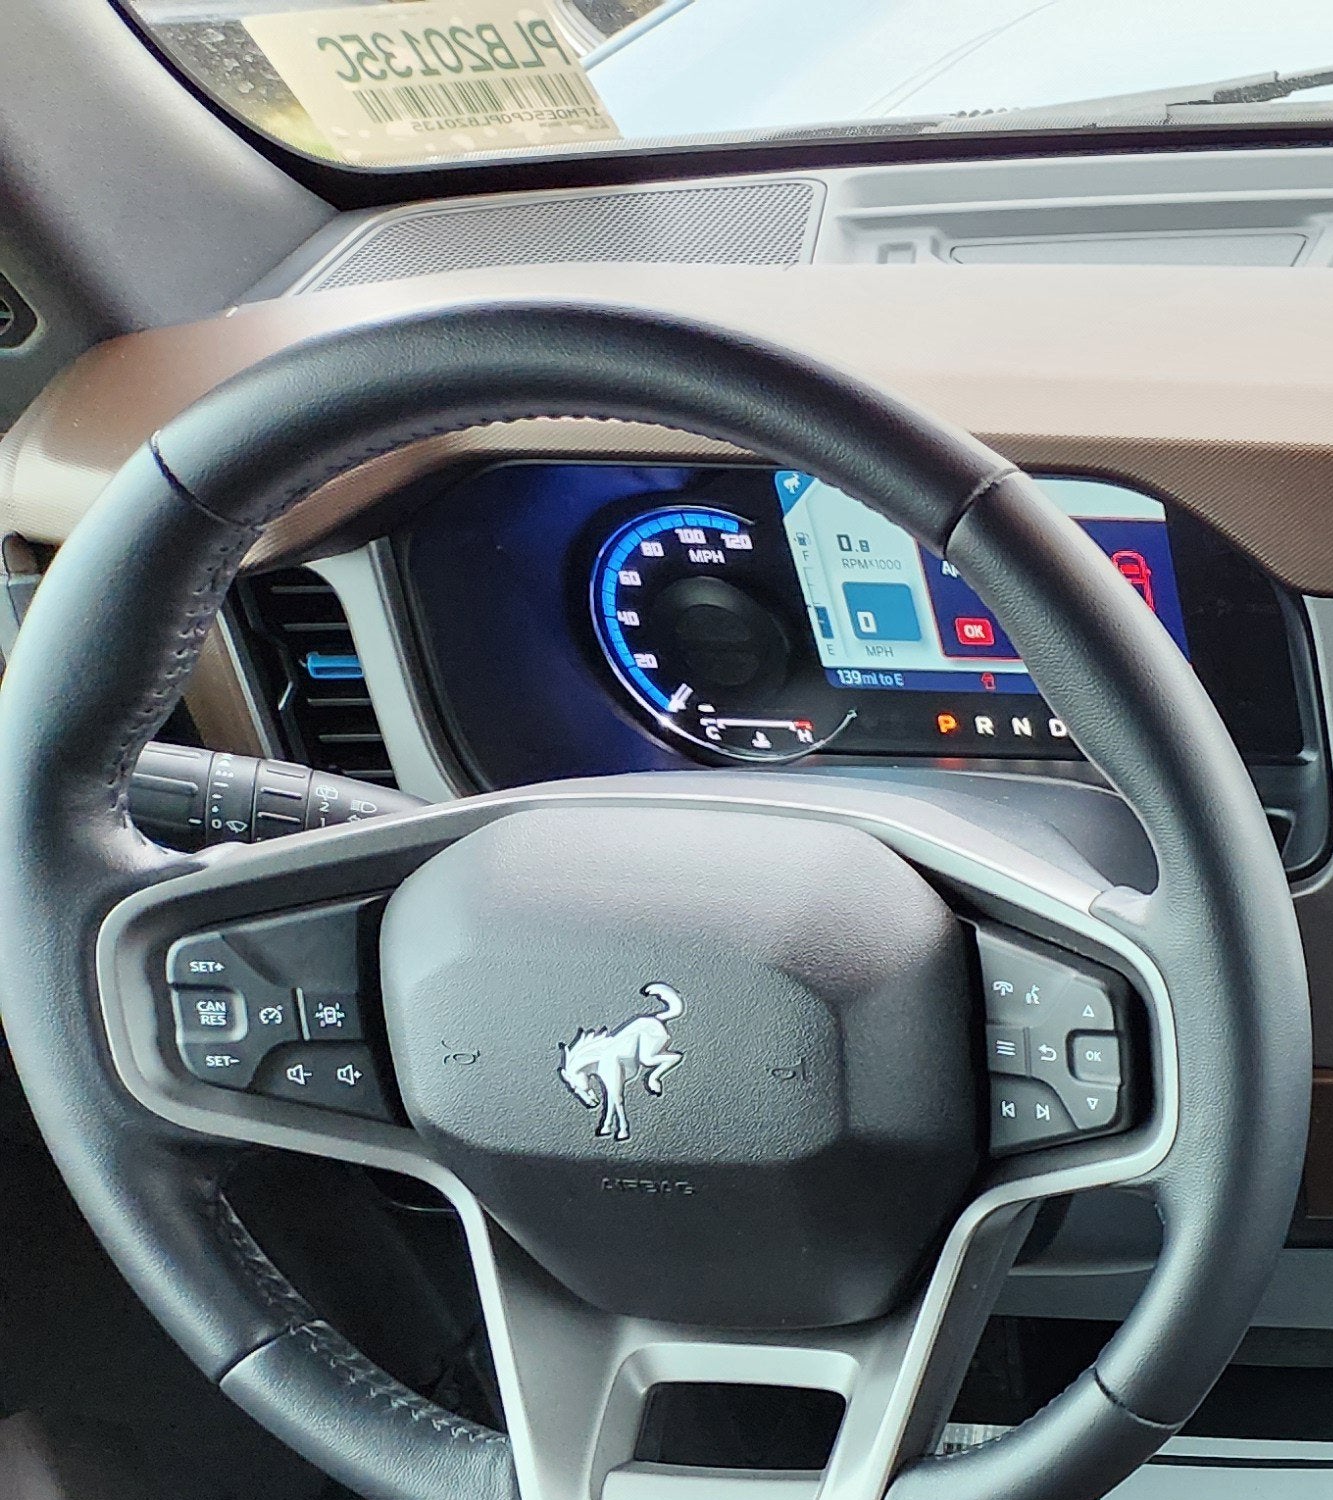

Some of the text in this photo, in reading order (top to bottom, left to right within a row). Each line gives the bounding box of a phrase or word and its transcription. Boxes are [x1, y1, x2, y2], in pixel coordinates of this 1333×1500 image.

[675, 529, 706, 544] 100
[721, 533, 753, 549] 120
[836, 534, 871, 553] 0.8
[641, 542, 664, 556] 80
[688, 549, 726, 564] MPH
[618, 570, 642, 586] 60
[616, 610, 640, 626] 40
[856, 611, 877, 633] 0
[963, 624, 986, 639] OK
[826, 644, 835, 656] E
[865, 645, 894, 657] MPH
[633, 653, 658, 669] 20
[836, 669, 862, 685] 139
[880, 673, 893, 686] to
[894, 673, 904, 686] E
[937, 715, 1068, 738] P R N D
[320, 801, 330, 812] 2
[196, 1001, 227, 1012] CAN
[200, 1015, 227, 1026] RES
[1085, 1050, 1102, 1062] OK
